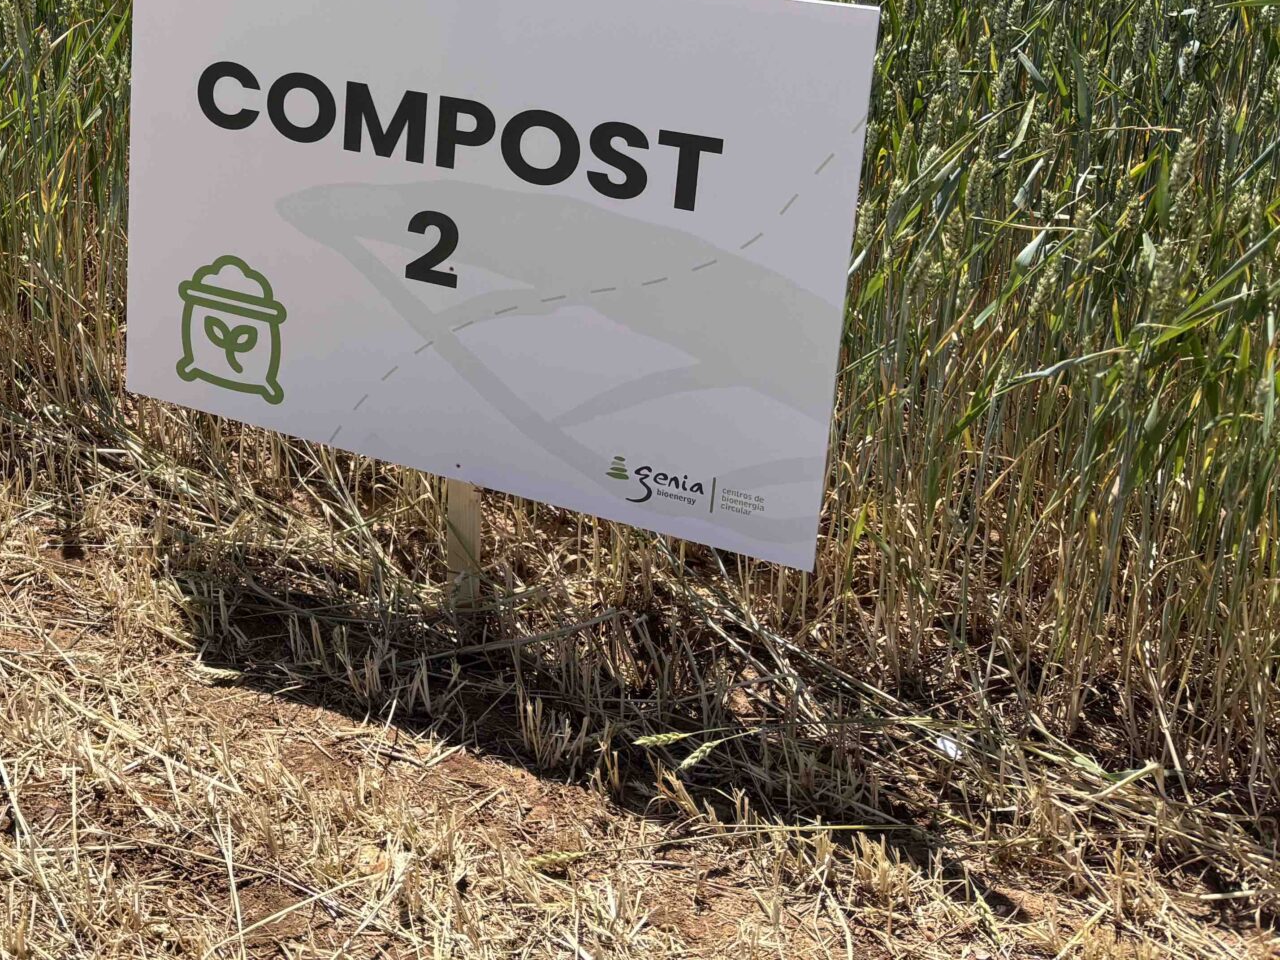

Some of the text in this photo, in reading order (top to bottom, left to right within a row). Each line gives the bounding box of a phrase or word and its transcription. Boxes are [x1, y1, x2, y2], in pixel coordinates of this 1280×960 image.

[197, 60, 723, 212] COMPOST
[405, 210, 459, 288] 2
[625, 465, 704, 503] genia
[656, 488, 697, 506] bioenergy
[722, 487, 765, 504] centros de
[720, 503, 752, 515] circular
